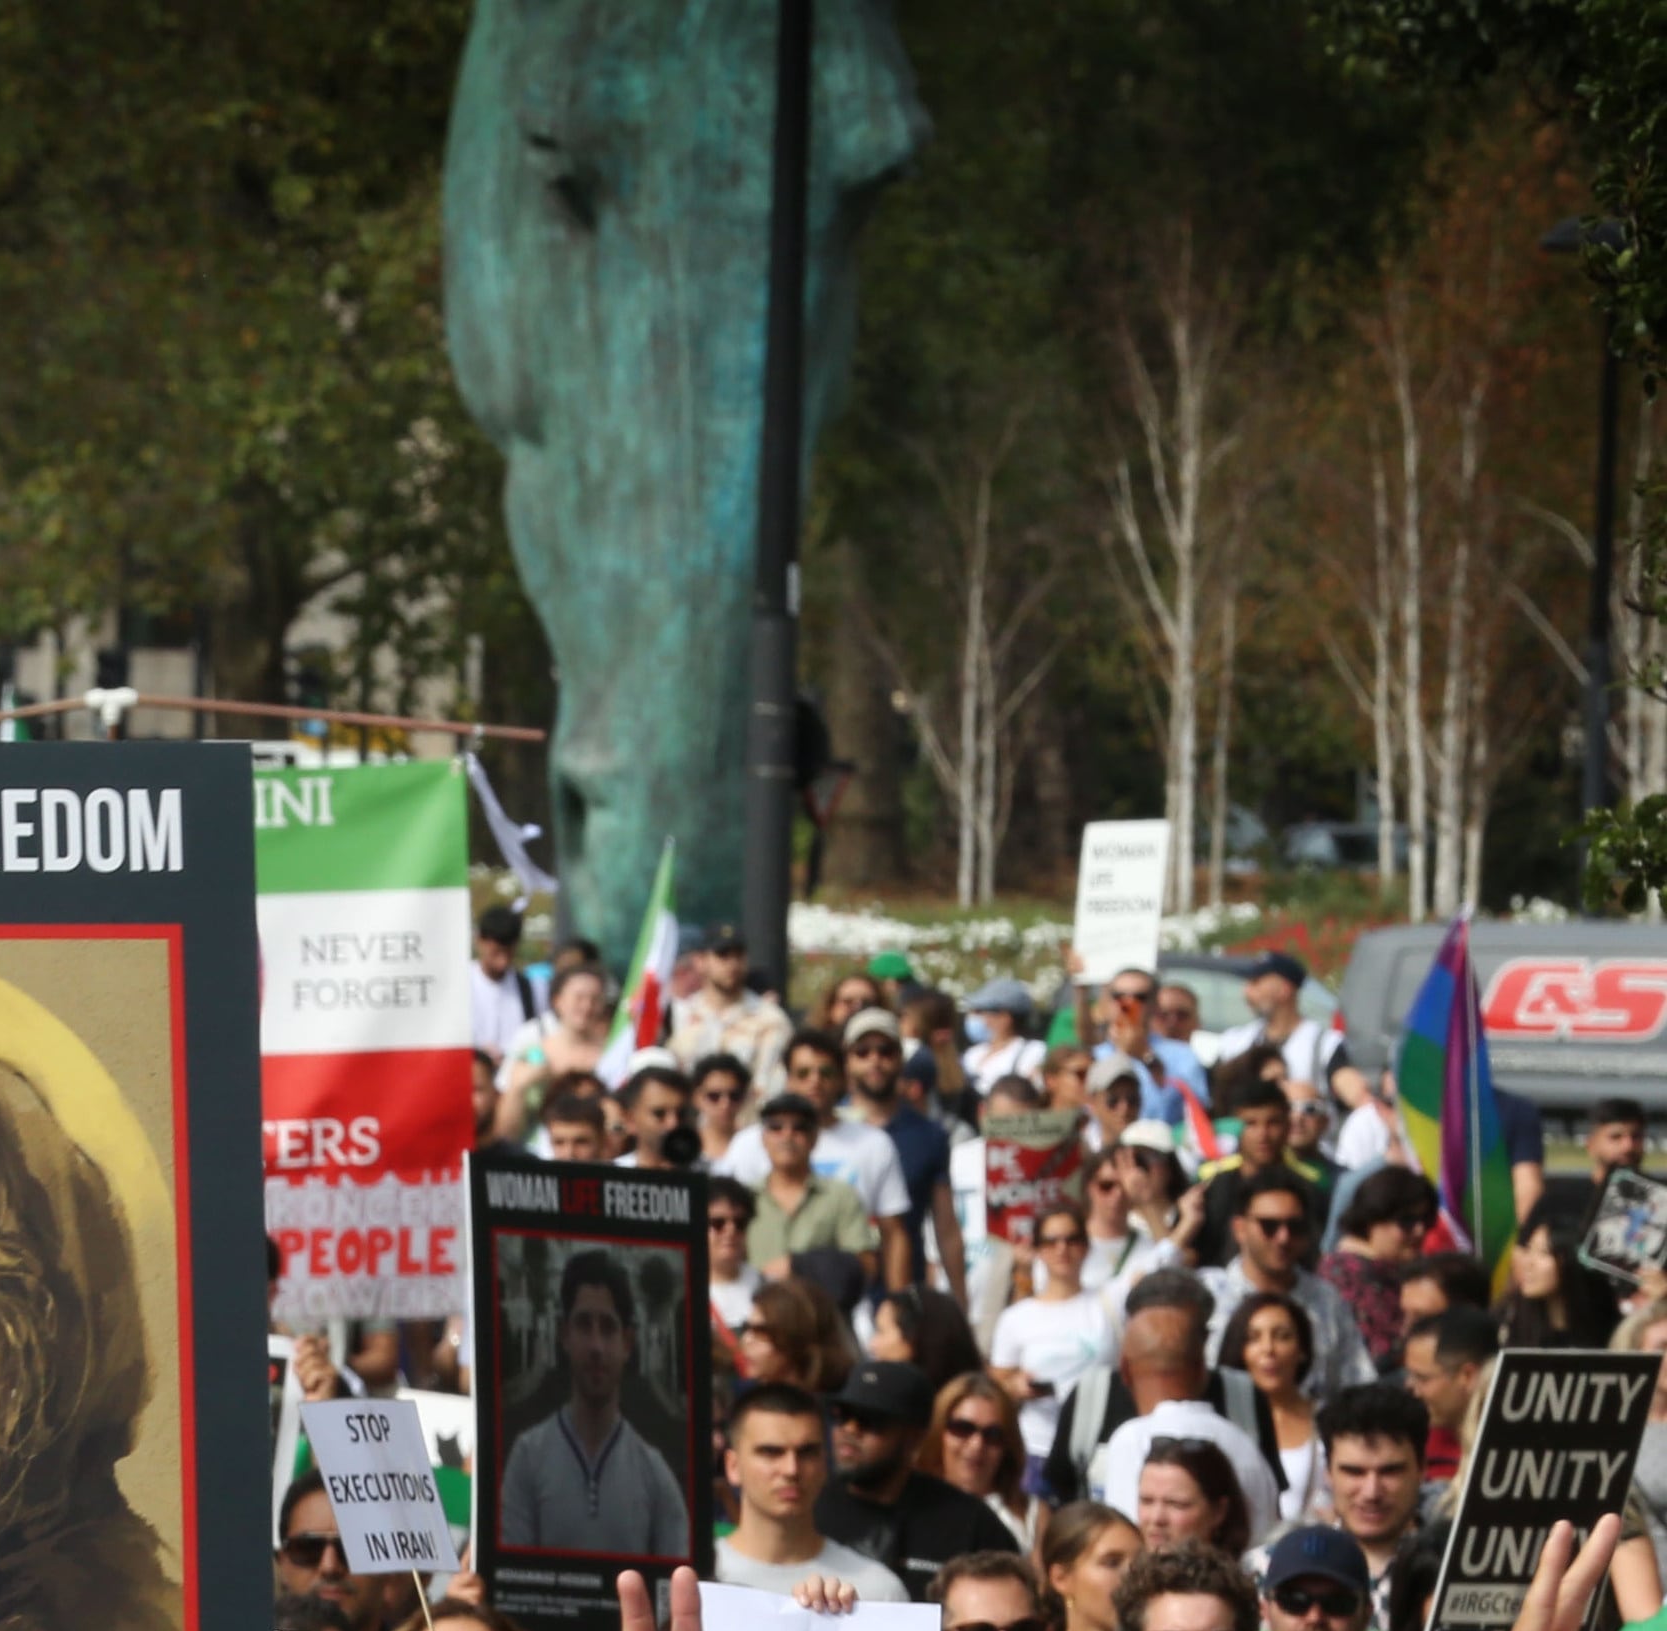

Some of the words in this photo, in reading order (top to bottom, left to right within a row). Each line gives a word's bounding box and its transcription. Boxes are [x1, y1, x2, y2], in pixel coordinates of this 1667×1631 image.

[300, 934, 424, 964] NEVER
[292, 974, 434, 1011] FORGET
[486, 1170, 560, 1213] WOMAN
[562, 1177, 601, 1216] LIFE
[603, 1179, 691, 1224] FREEDOM
[271, 1226, 459, 1281] PEOPLE
[1501, 1372, 1648, 1423] UNITY
[345, 1413, 391, 1444] STOP
[328, 1471, 435, 1504] EXECUTIONS
[1480, 1450, 1629, 1500] UNITY
[365, 1532, 392, 1563] IN
[392, 1529, 440, 1562] IRAN!
